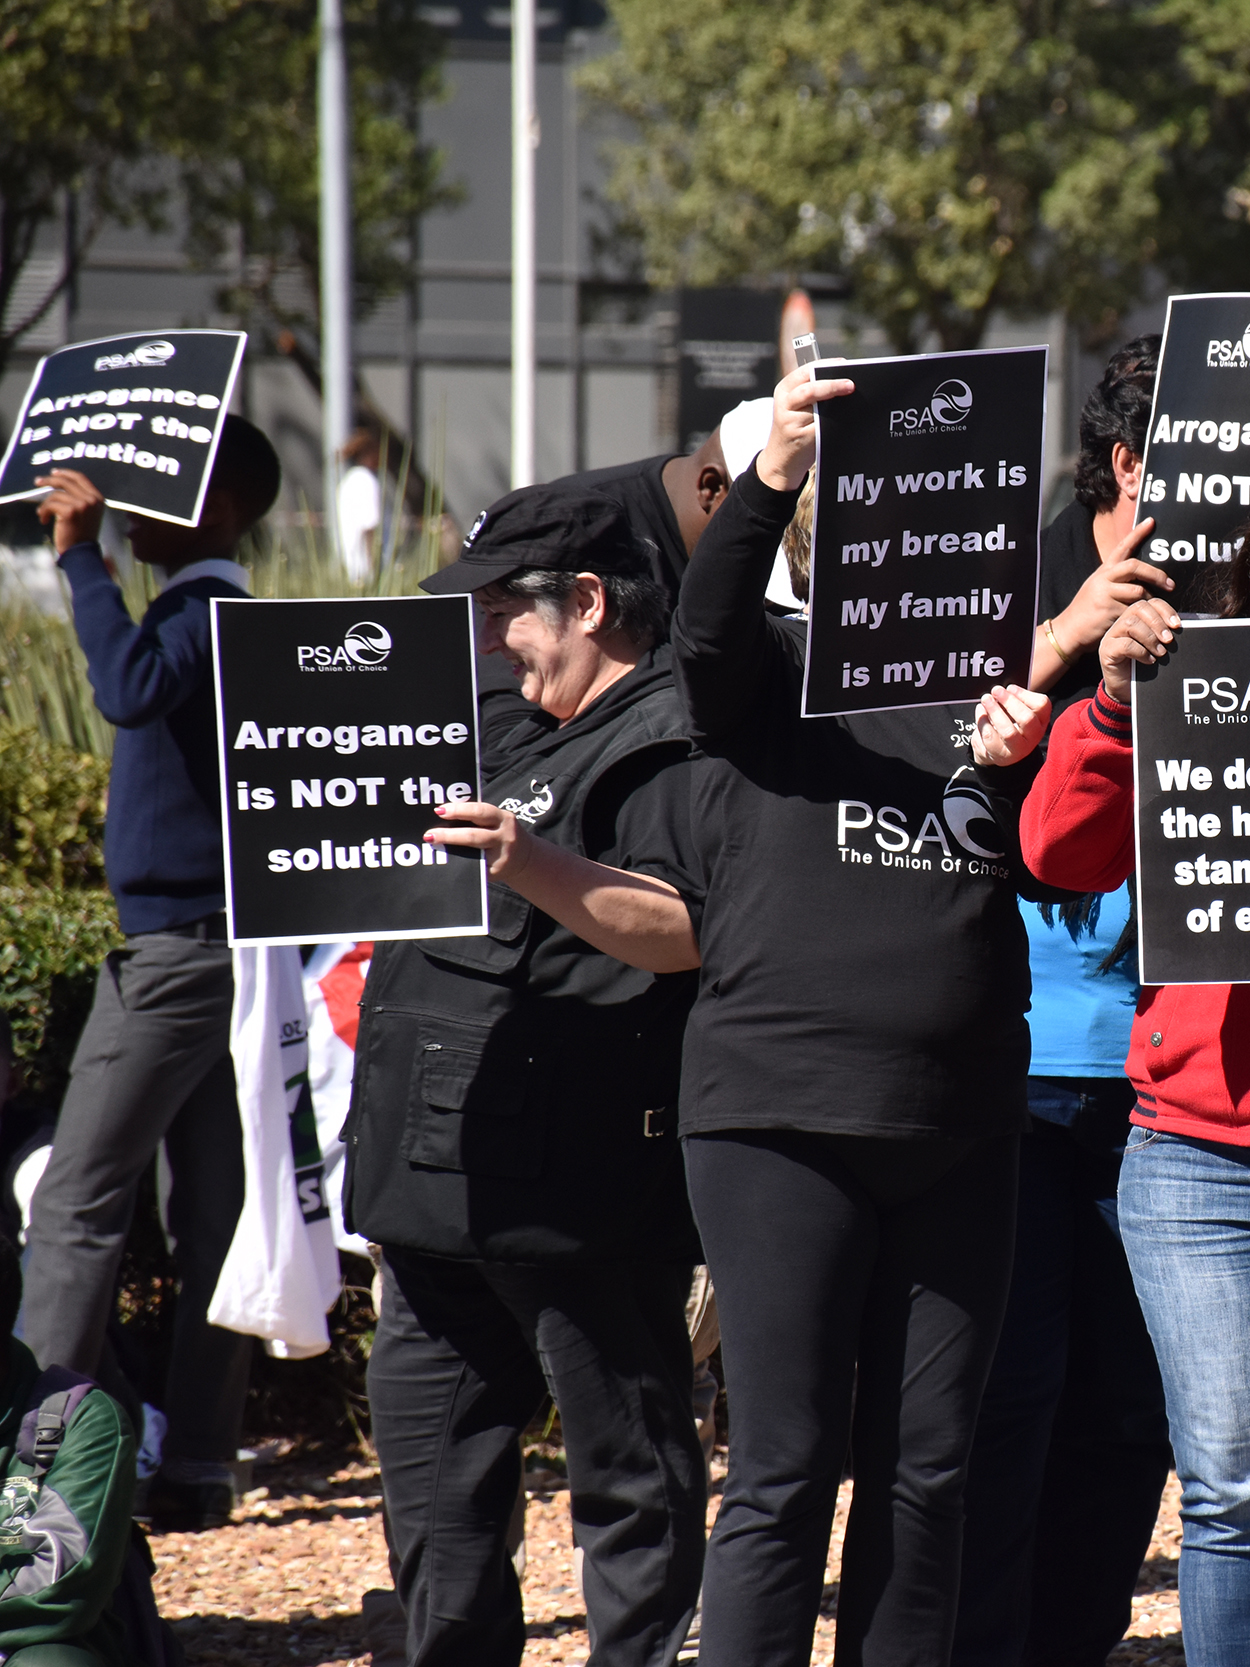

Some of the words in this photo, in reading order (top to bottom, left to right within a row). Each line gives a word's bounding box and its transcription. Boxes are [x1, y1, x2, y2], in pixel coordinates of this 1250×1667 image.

[1206, 340, 1245, 361] PSA
[1240, 360, 1248, 368] Of
[29, 387, 221, 417] Arrogance
[20, 426, 52, 445] is
[61, 412, 143, 435] NOT
[151, 415, 212, 443] the
[889, 407, 934, 431] PSA
[905, 428, 927, 436] Union
[940, 424, 967, 432] Choice
[30, 441, 181, 476] solution
[837, 473, 885, 506] My
[895, 462, 985, 494] work
[997, 459, 1028, 487] is
[1143, 474, 1166, 502] is
[841, 538, 891, 567] my
[901, 523, 1016, 556] bread.
[1149, 534, 1245, 563] solu
[841, 597, 888, 629] My
[899, 587, 1013, 621] family
[297, 646, 352, 666] PSA
[841, 662, 870, 688] is
[882, 659, 935, 687] my
[947, 651, 1005, 678] life
[1184, 714, 1210, 725] The
[234, 721, 469, 754] Arrogance
[1155, 759, 1213, 792] We
[236, 781, 275, 810] is
[291, 777, 386, 808] NOT
[400, 776, 472, 805] the
[837, 799, 952, 857] PSA
[1160, 806, 1221, 839] the
[267, 837, 448, 872] solution
[838, 847, 873, 865] The
[881, 851, 932, 871] Union
[941, 858, 961, 873] Of
[1186, 899, 1224, 933] of
